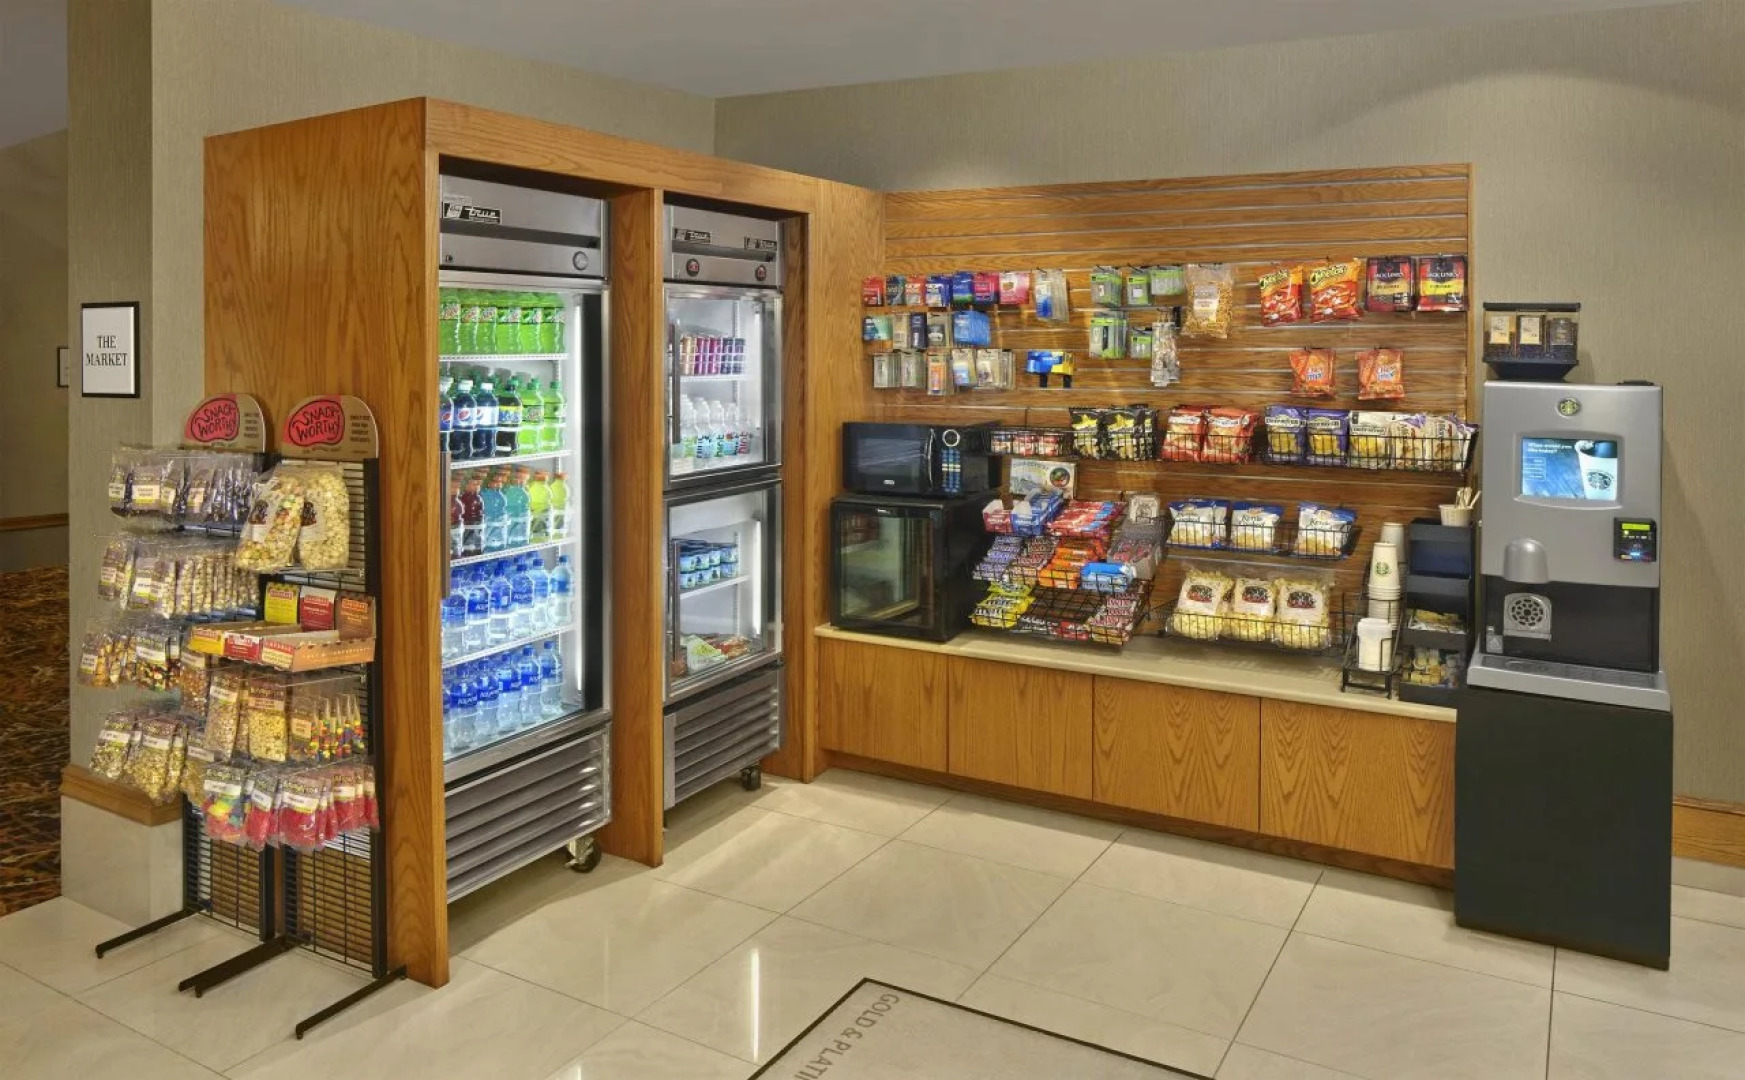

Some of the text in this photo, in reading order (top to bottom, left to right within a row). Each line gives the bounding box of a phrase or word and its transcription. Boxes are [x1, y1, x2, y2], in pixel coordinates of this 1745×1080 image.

[97, 335, 117, 349] THE
[86, 352, 127, 366] MARKET
[195, 403, 237, 423] SNACK
[292, 406, 339, 427] SNACK
[198, 412, 238, 438] WORTHY
[296, 414, 340, 442] WORTHY
[855, 993, 900, 1028] GOLD
[841, 1027, 862, 1039] &
